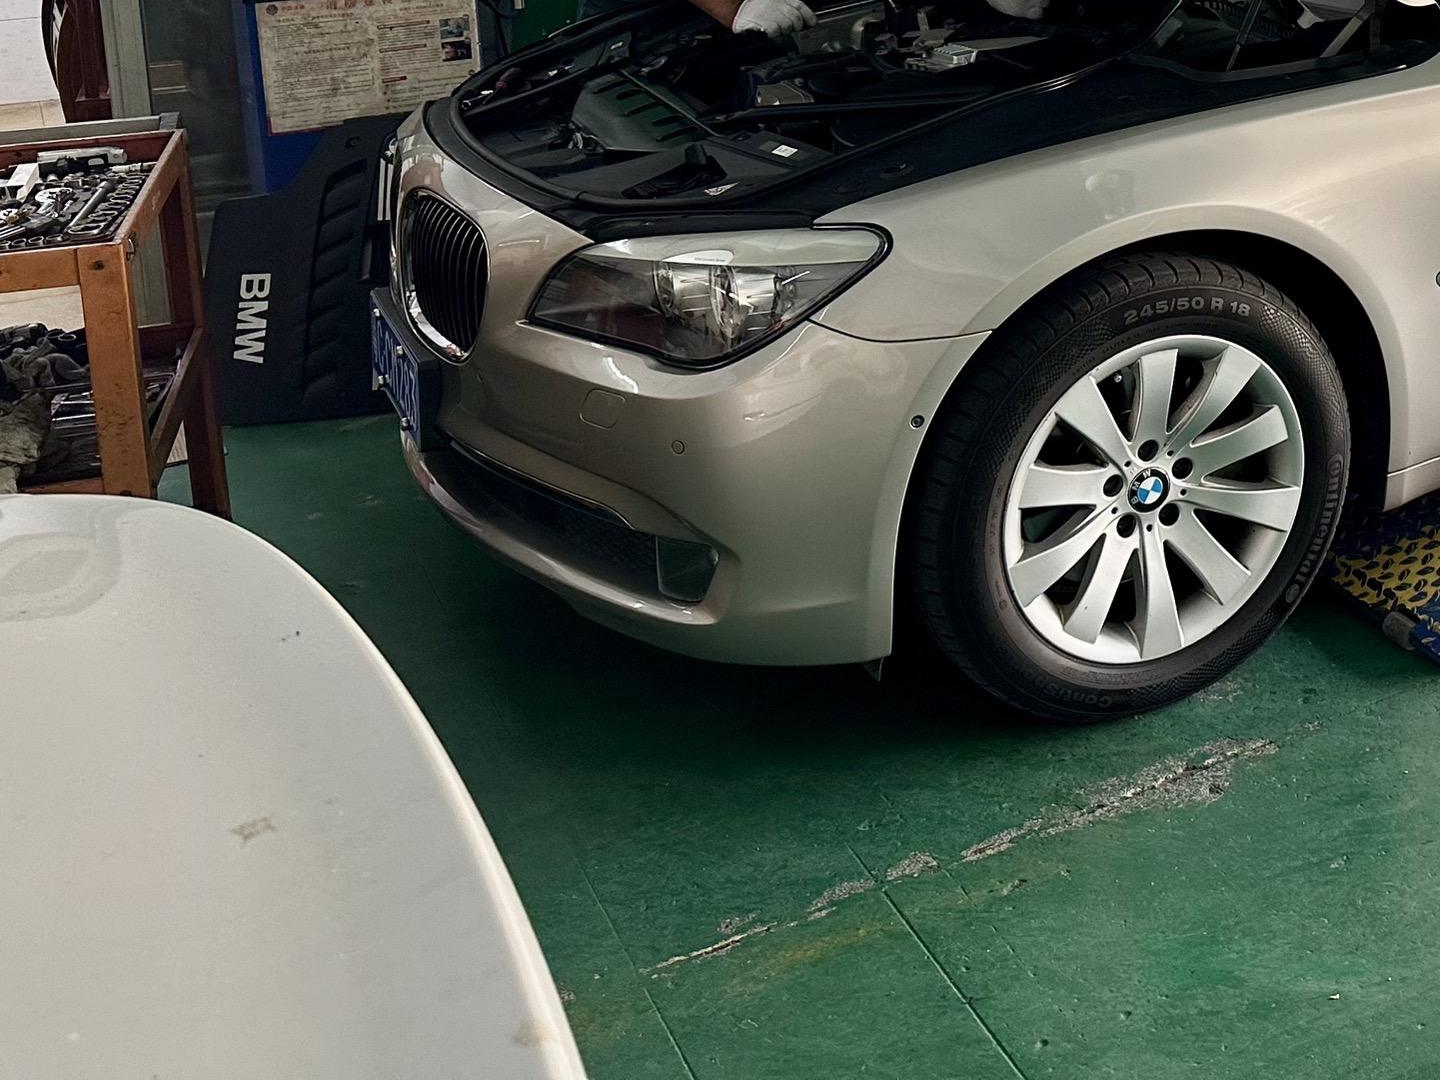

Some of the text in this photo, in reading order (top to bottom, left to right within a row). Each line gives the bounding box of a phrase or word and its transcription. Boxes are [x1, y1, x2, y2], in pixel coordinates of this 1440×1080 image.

[233, 273, 271, 364] BMW
[1124, 296, 1251, 324] 245/50 R 18
[1131, 469, 1151, 504] BMW
